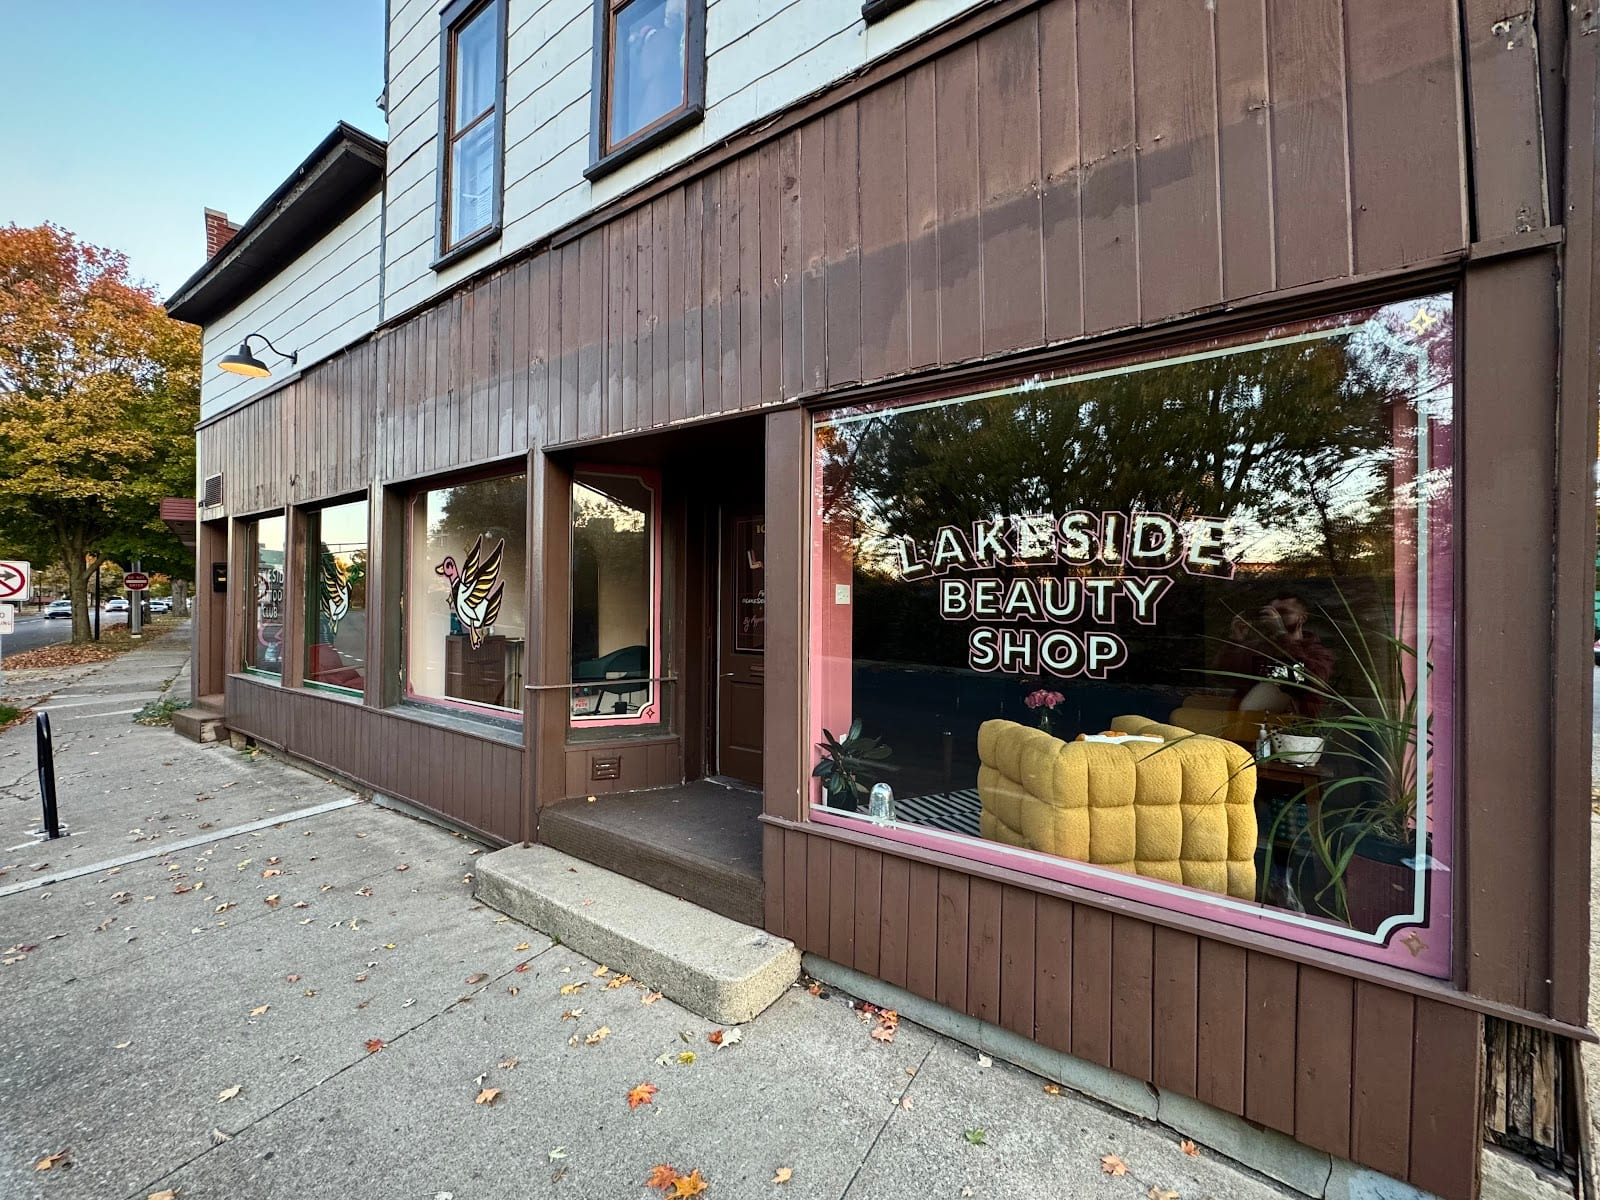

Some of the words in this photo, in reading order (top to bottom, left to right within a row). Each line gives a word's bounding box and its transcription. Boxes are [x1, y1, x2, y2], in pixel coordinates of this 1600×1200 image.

[896, 510, 1239, 582] LAKESIDE
[262, 606, 278, 618] CLUB
[939, 575, 1175, 625] BEAUTY
[968, 626, 1129, 680] SHOP
